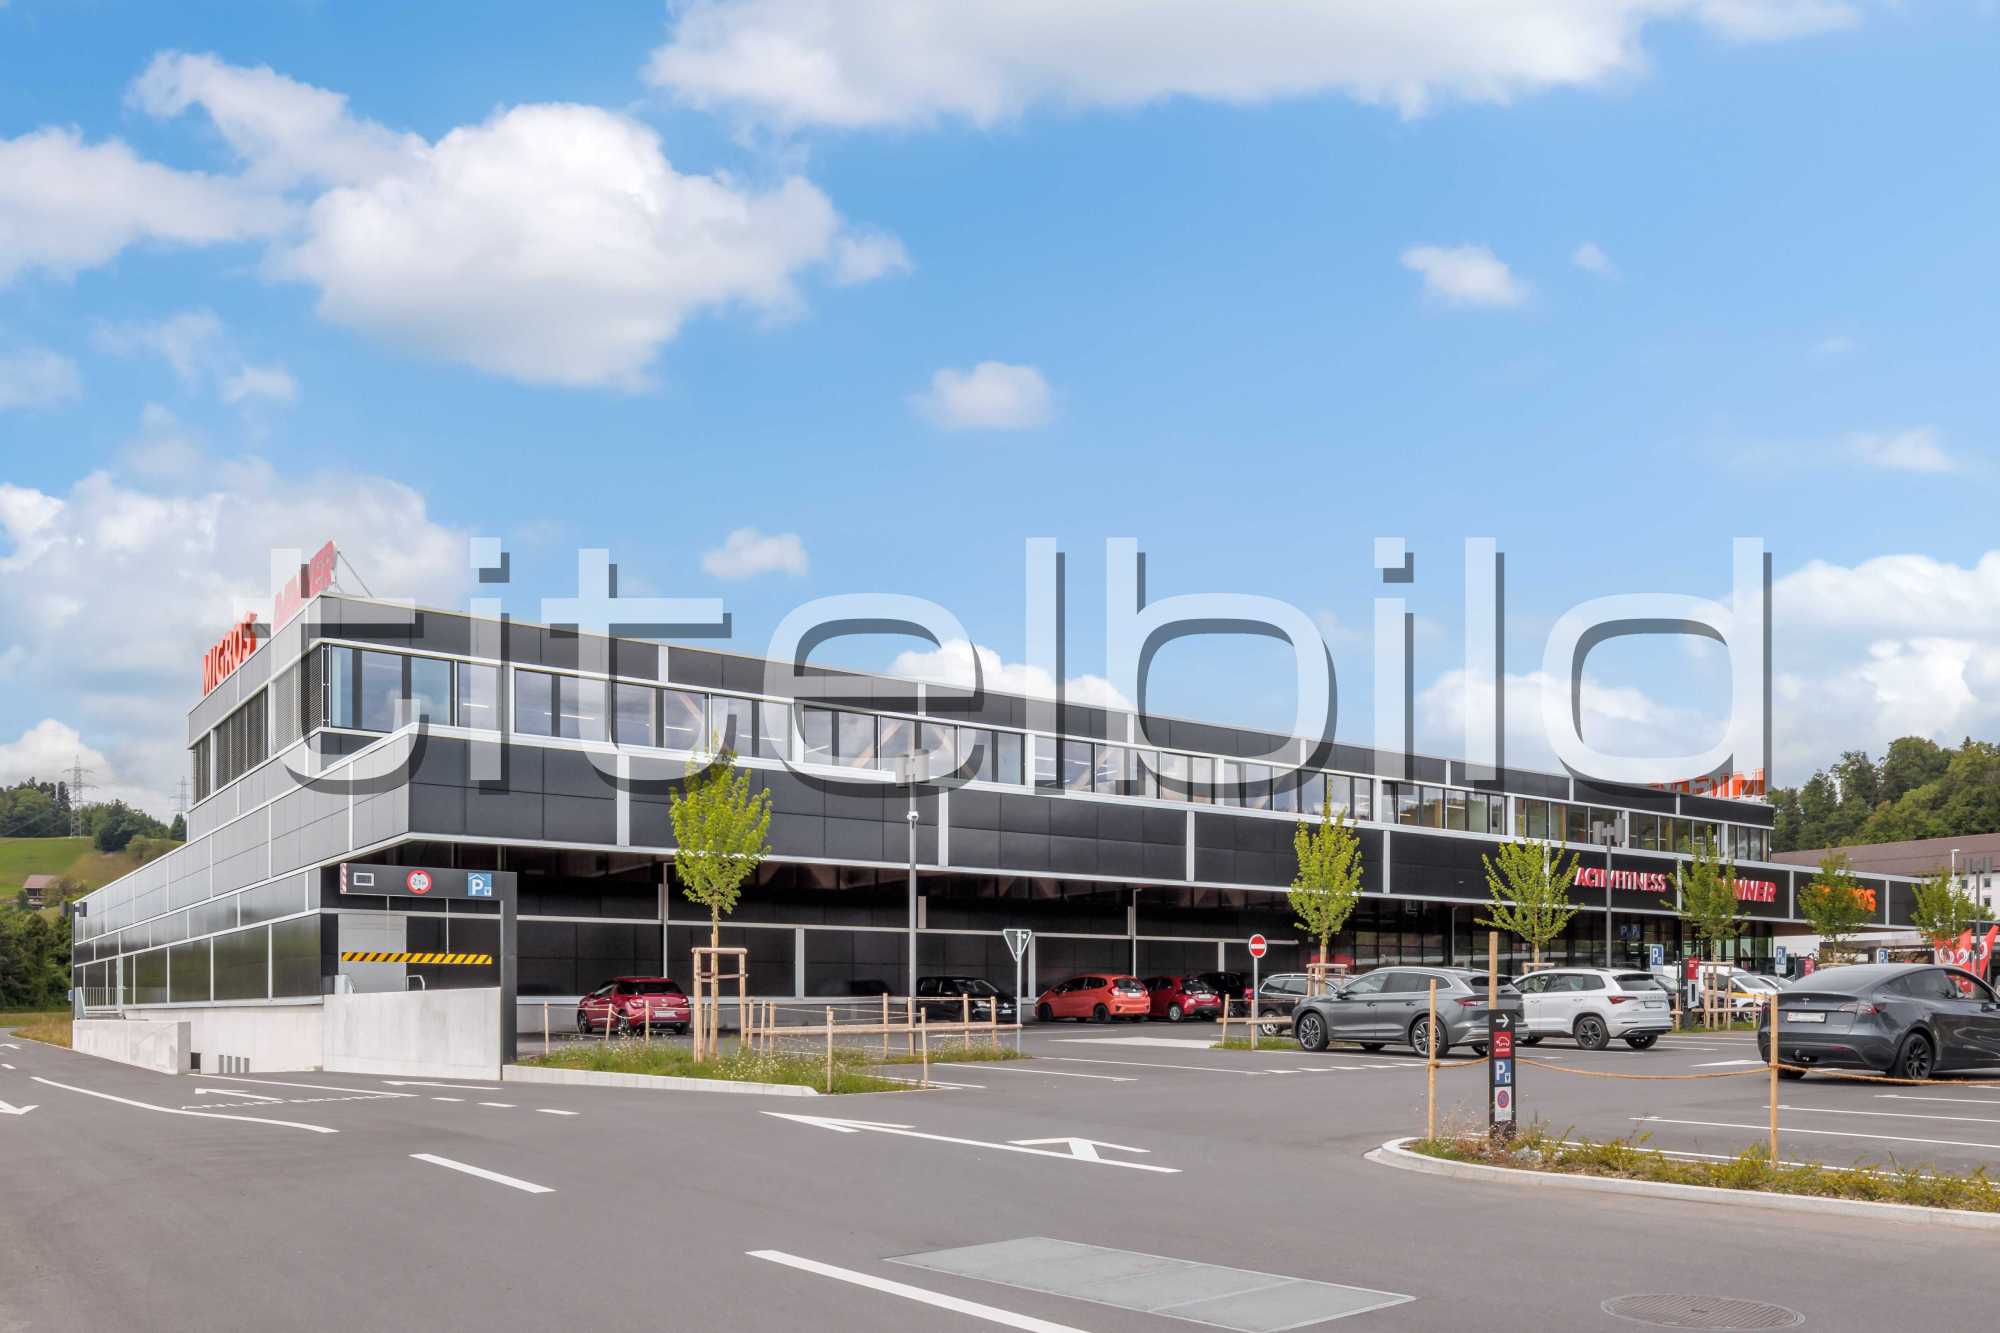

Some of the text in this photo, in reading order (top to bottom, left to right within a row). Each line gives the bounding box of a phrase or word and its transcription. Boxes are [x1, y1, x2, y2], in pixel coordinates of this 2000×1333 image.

[203, 613, 257, 696] MIGROS
[472, 879, 484, 895] P
[1496, 1061, 1506, 1081] P
